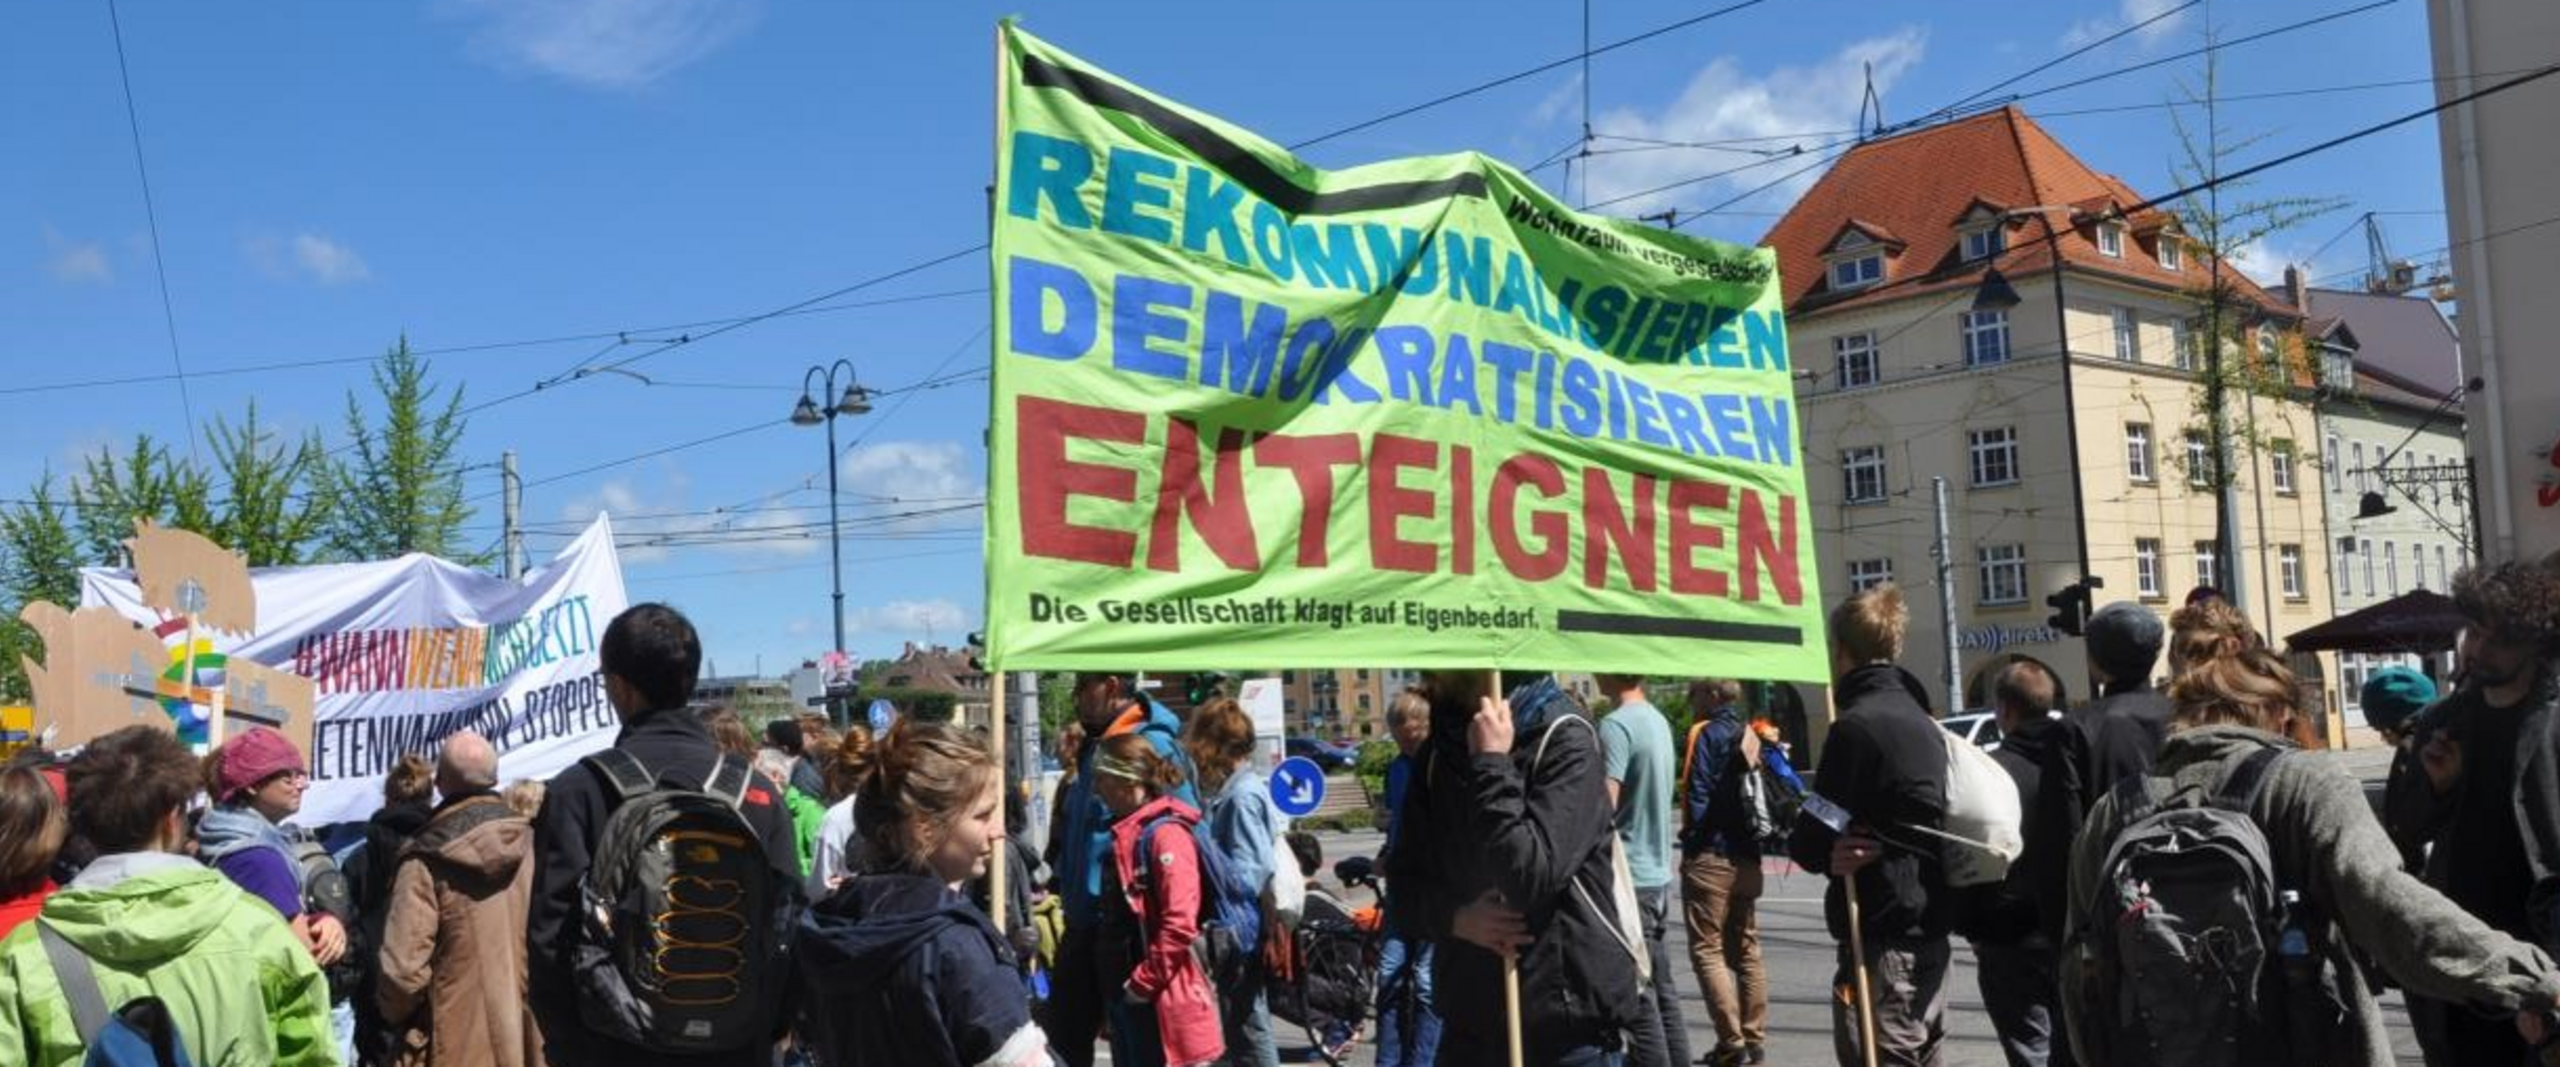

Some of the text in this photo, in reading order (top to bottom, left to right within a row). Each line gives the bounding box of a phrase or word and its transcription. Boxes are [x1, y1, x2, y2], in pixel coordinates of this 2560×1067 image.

[1008, 130, 1787, 373] REKOMMUNALISIEREN
[1010, 257, 1792, 466] DEMOKRATISIEREN
[1016, 395, 1803, 606] ENTEIGNEN
[1029, 592, 1540, 633] Die Gesellschaft klagt auf Eigenbedarf.
